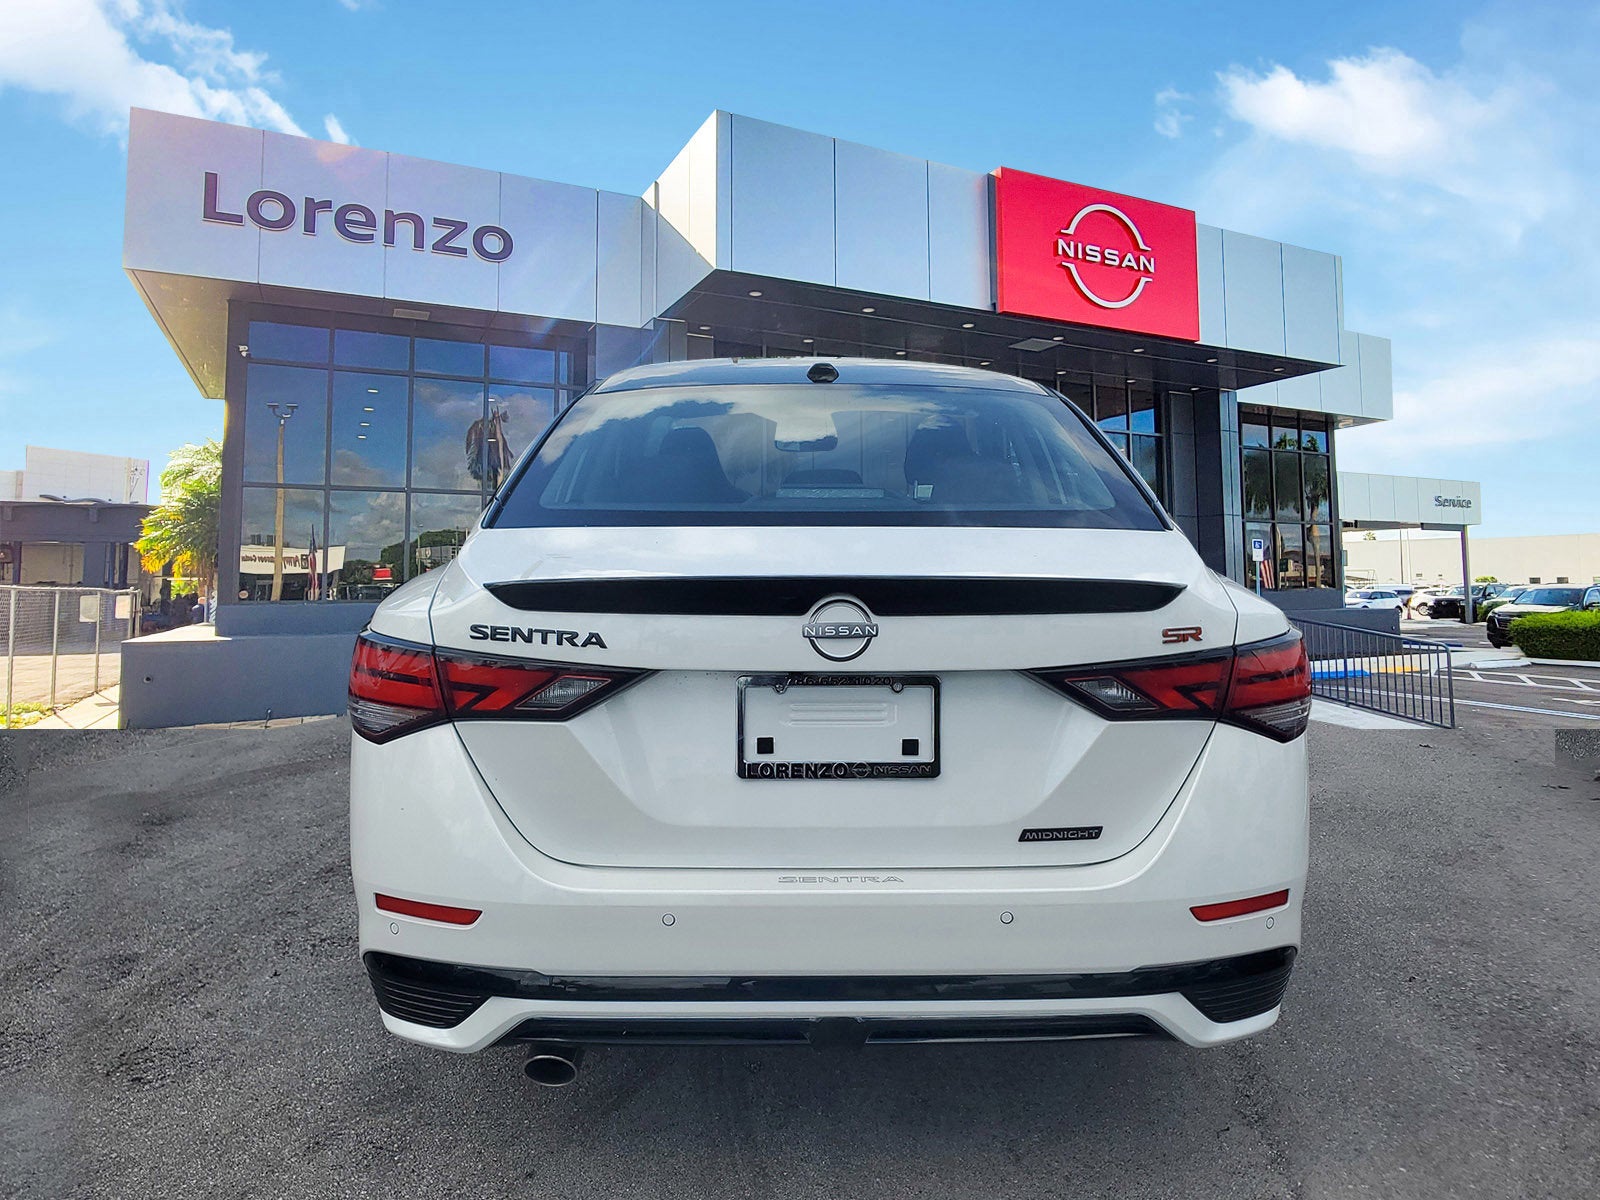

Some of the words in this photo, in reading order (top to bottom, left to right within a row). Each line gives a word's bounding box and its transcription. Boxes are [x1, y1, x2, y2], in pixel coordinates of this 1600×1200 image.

[202, 171, 514, 262] Lorenzo
[1057, 238, 1155, 273] NISSAN
[1435, 495, 1472, 508] Service
[469, 624, 608, 649] SENTRA
[804, 626, 877, 636] NISSAN
[1162, 626, 1203, 644] SR
[745, 761, 849, 778] LORENZO
[873, 764, 932, 775] NISSAN
[1024, 829, 1099, 840] MIDNIGHT
